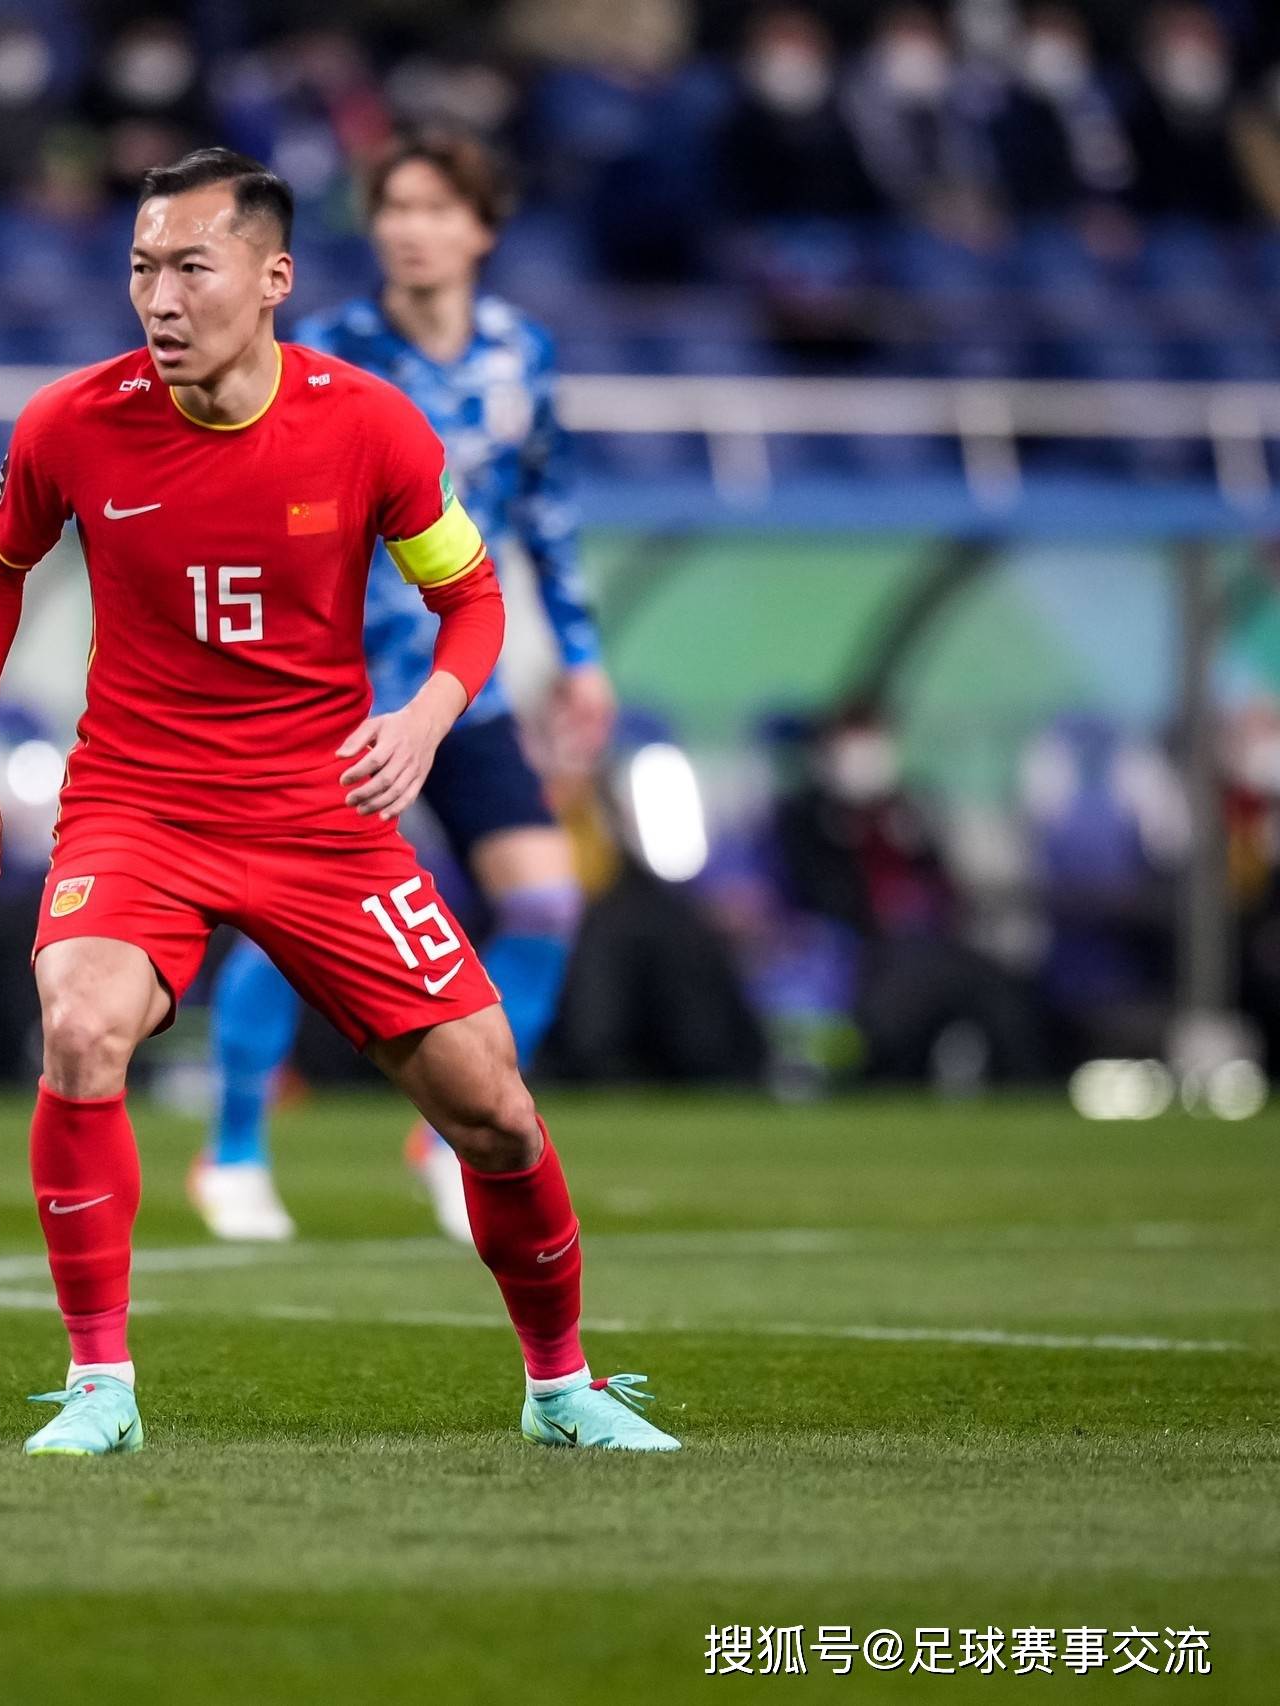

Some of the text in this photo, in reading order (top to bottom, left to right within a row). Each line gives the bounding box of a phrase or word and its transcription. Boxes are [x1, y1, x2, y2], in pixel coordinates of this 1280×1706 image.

[308, 373, 331, 387] 中国
[186, 565, 263, 643] 15
[361, 875, 461, 970] 15
